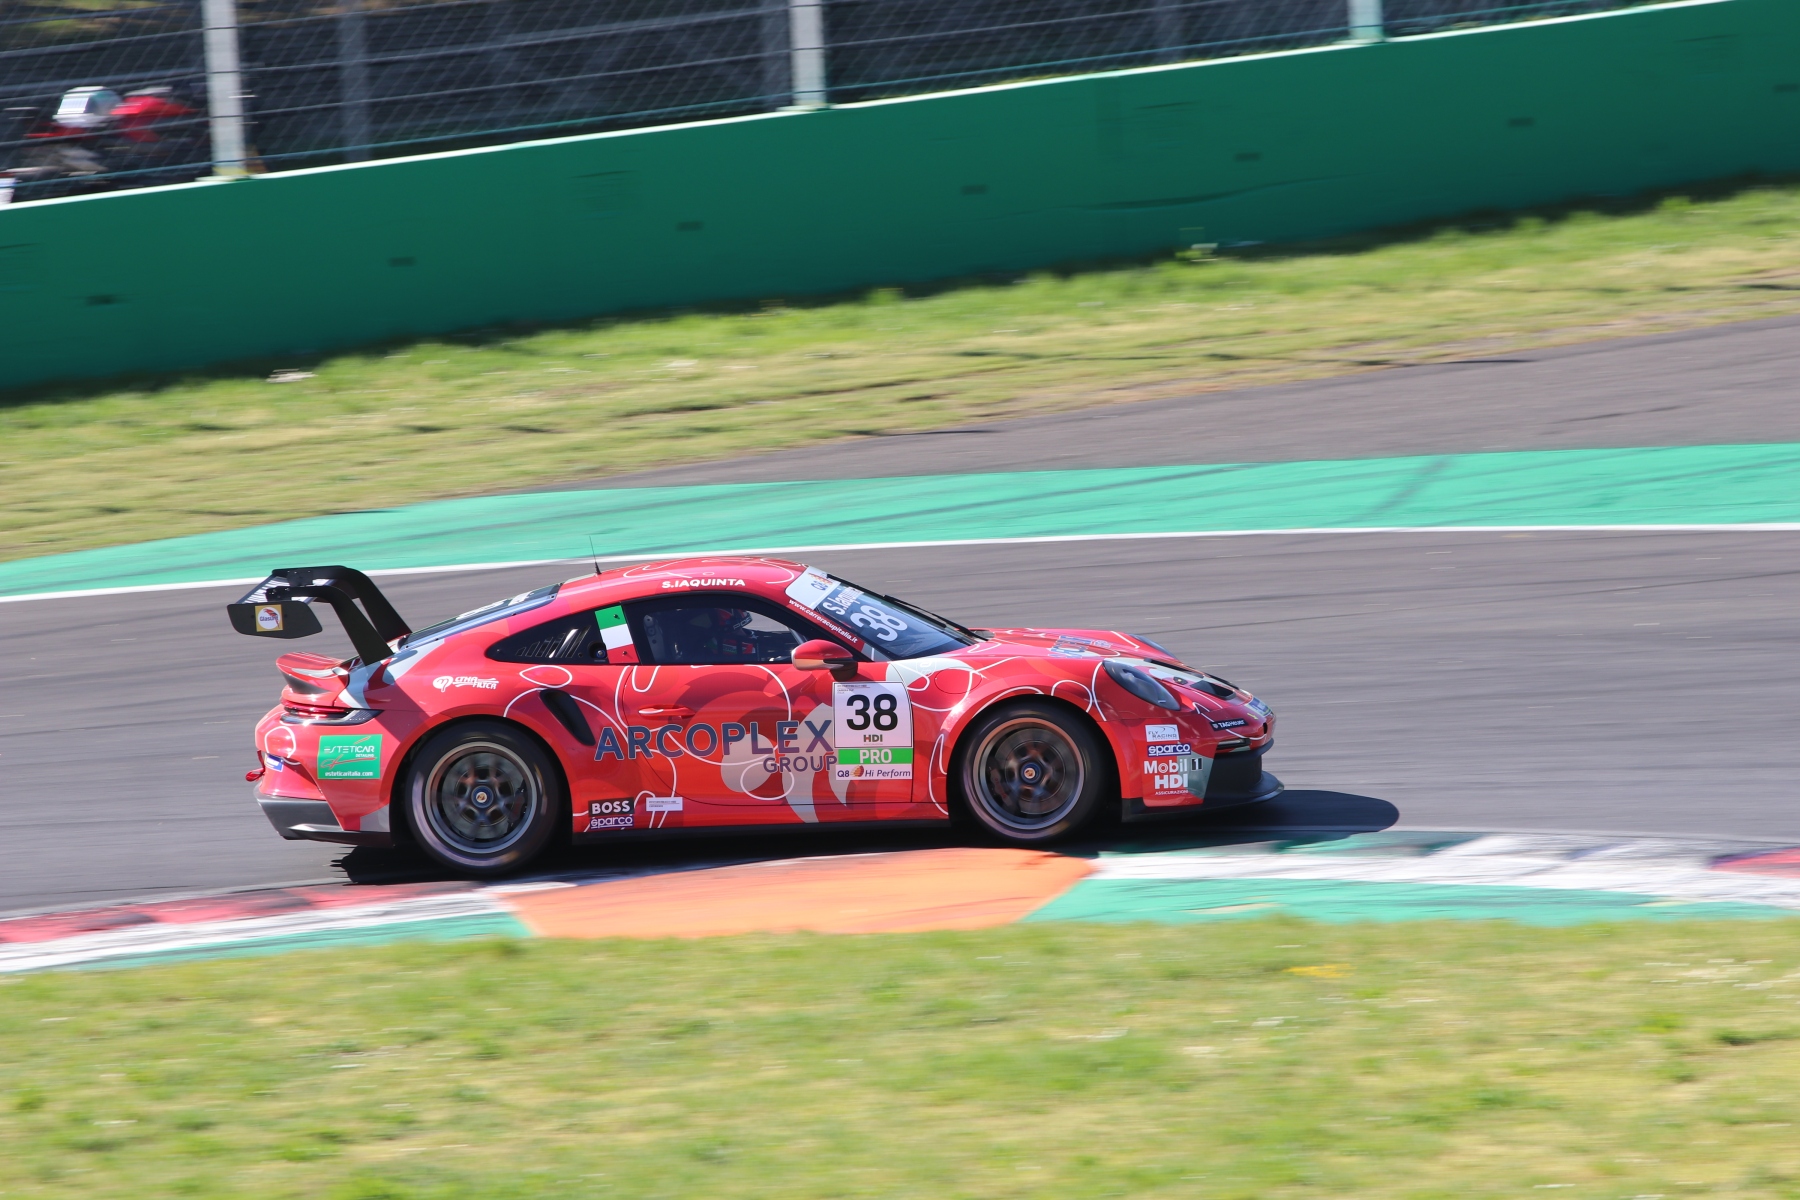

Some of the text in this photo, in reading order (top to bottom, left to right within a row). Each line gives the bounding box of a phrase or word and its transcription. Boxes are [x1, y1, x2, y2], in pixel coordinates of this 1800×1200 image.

[662, 578, 746, 589] S.IAQUINTA
[788, 599, 858, 643] www.carreracupitalia.it
[850, 604, 908, 642] 38
[846, 693, 899, 732] 38
[594, 719, 835, 762] ARCOPLEX
[863, 734, 884, 743] HDI
[859, 748, 893, 764] PRO
[1148, 743, 1191, 757] sparco
[762, 755, 839, 773] GROUP
[1143, 758, 1188, 775] Mobil
[837, 768, 912, 779] Q8 Hi Perform
[1154, 773, 1189, 790] HDI
[592, 800, 631, 815] BOSS
[590, 815, 633, 829] sparco
